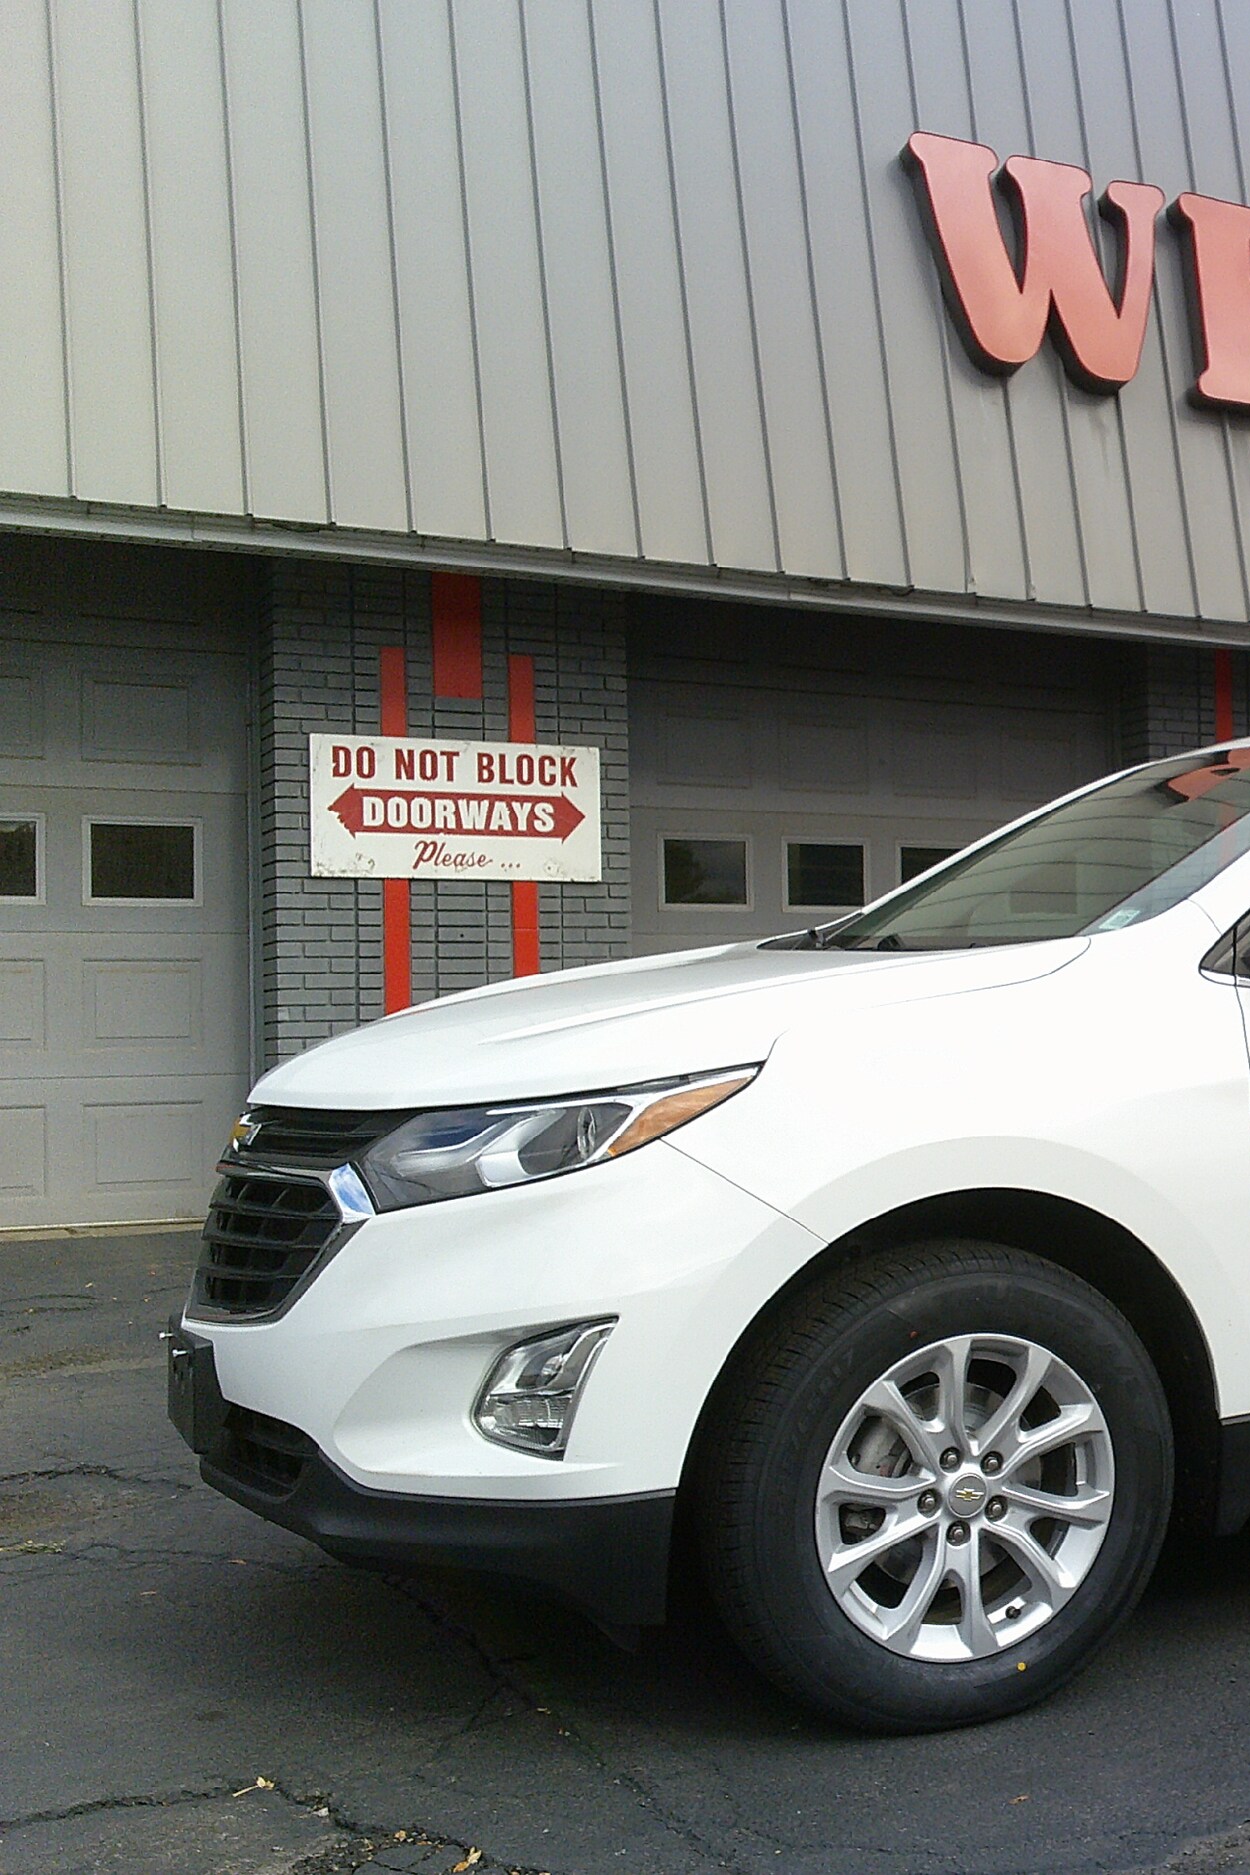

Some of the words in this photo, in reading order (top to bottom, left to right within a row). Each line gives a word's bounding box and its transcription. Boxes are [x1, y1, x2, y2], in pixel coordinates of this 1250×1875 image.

[332, 745, 376, 778] DO
[395, 748, 460, 783] NOT
[477, 752, 578, 788] BLOCK
[362, 796, 555, 833] DOORWAYS
[412, 840, 493, 870] Please
